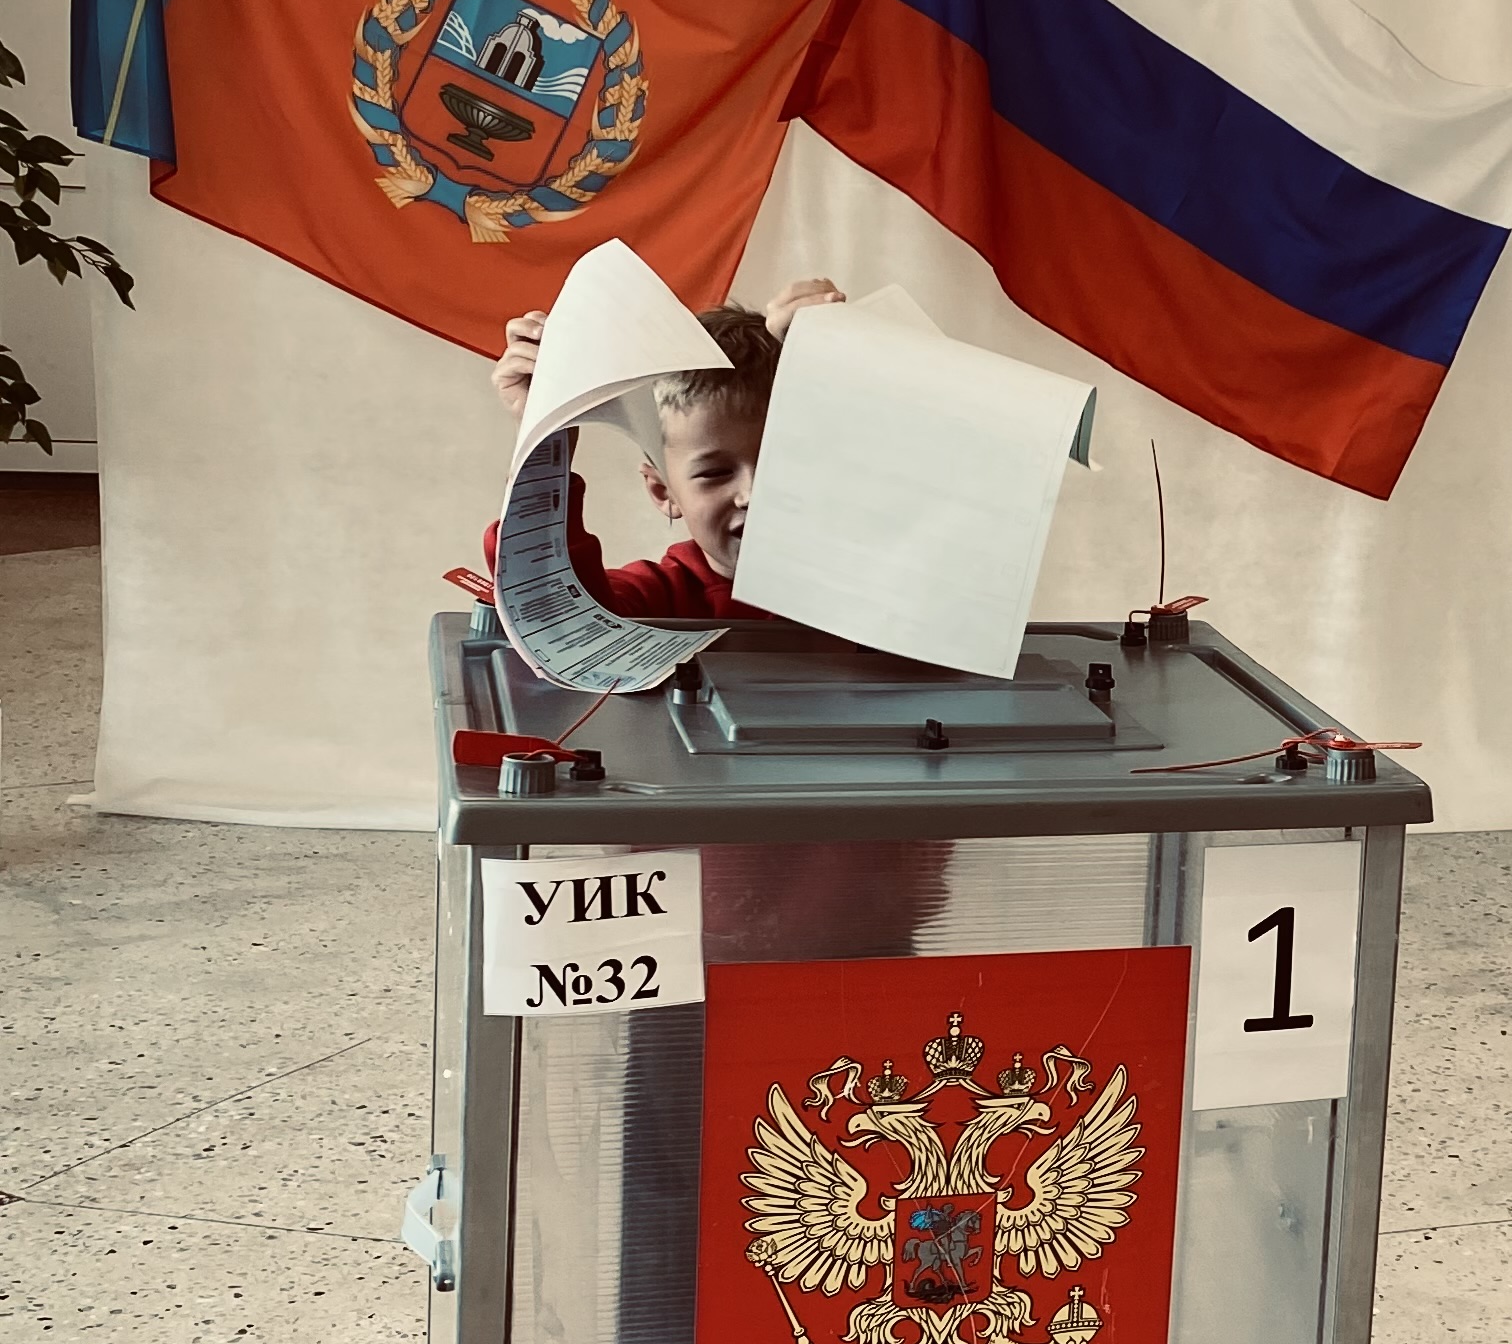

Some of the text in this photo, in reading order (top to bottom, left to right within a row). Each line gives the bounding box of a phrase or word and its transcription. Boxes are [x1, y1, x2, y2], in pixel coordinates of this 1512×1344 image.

[515, 869, 668, 927] УИК
[525, 955, 661, 1008] №32
[1241, 906, 1315, 1034] 1
